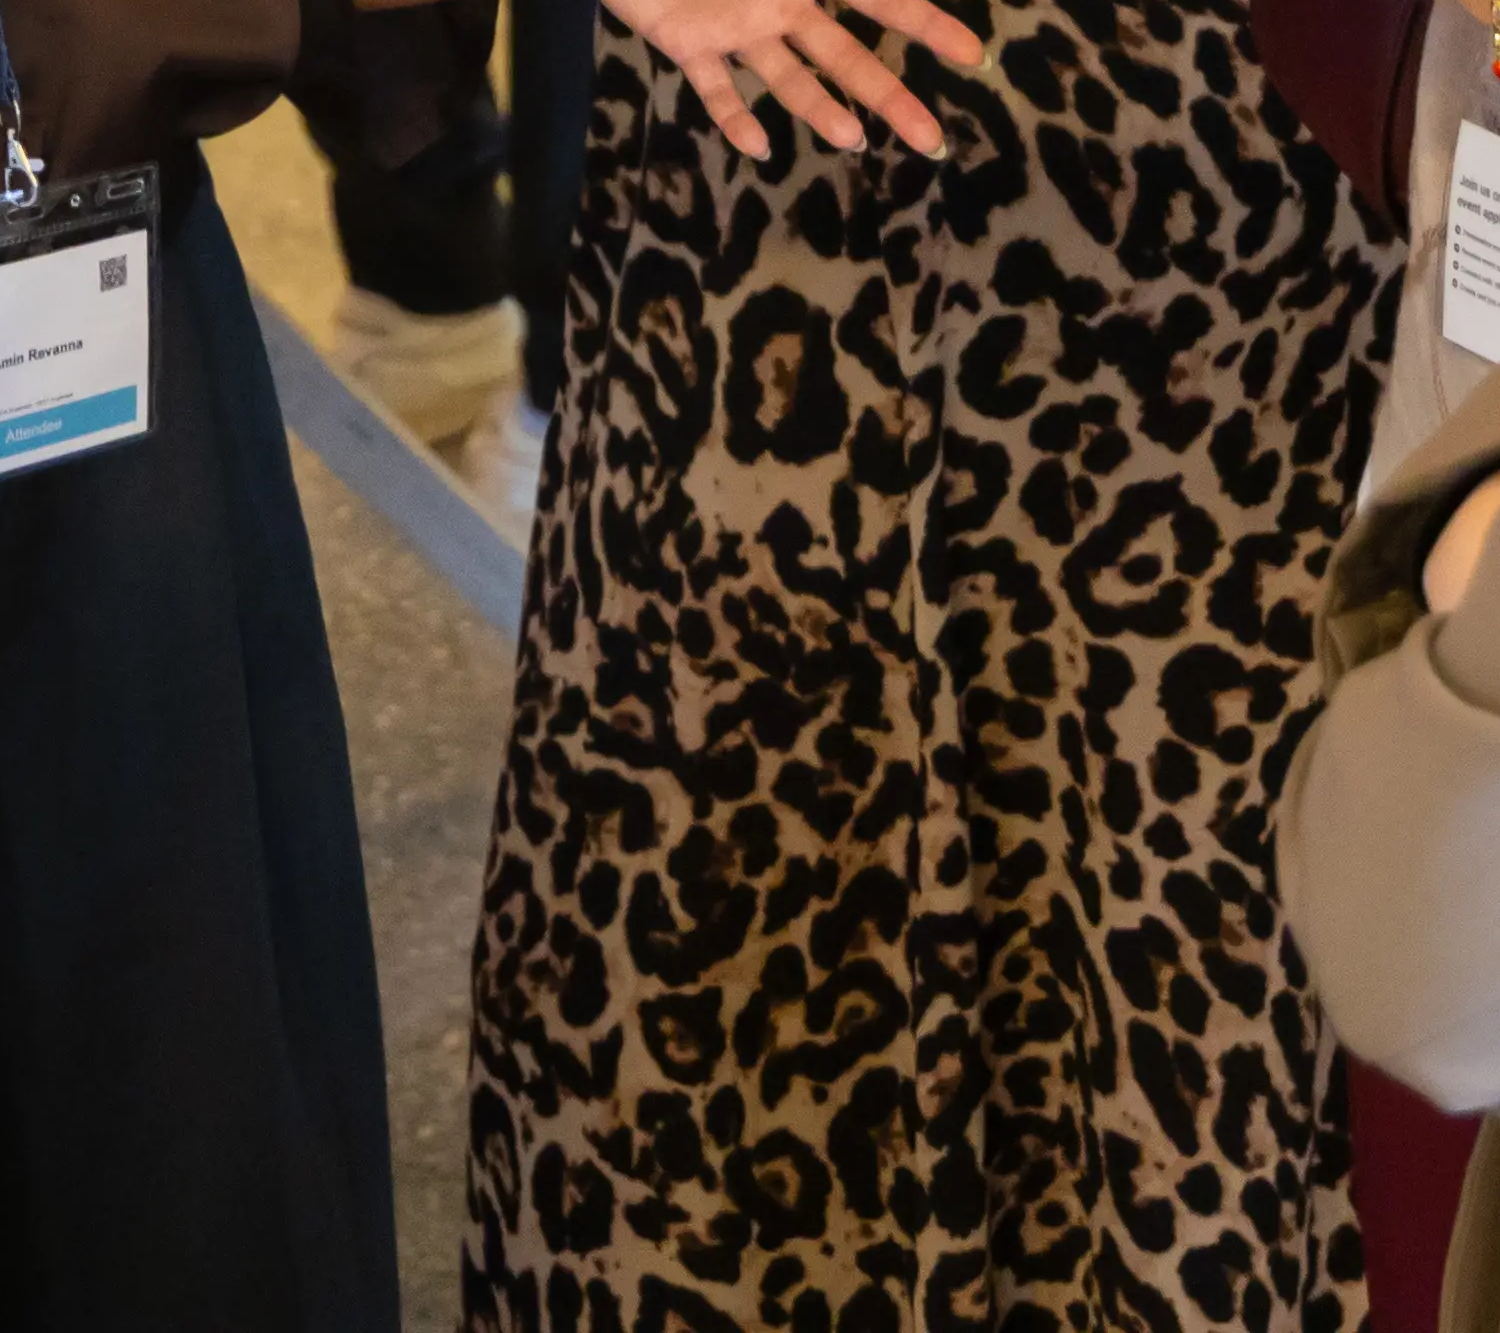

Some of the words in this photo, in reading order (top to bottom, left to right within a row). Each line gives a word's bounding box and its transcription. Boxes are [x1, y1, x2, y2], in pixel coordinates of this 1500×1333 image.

[1459, 174, 1479, 192] Join
[1480, 185, 1491, 199] us
[1456, 196, 1481, 216] event
[28, 338, 83, 362] Revanna
[4, 417, 63, 444] Attendee
